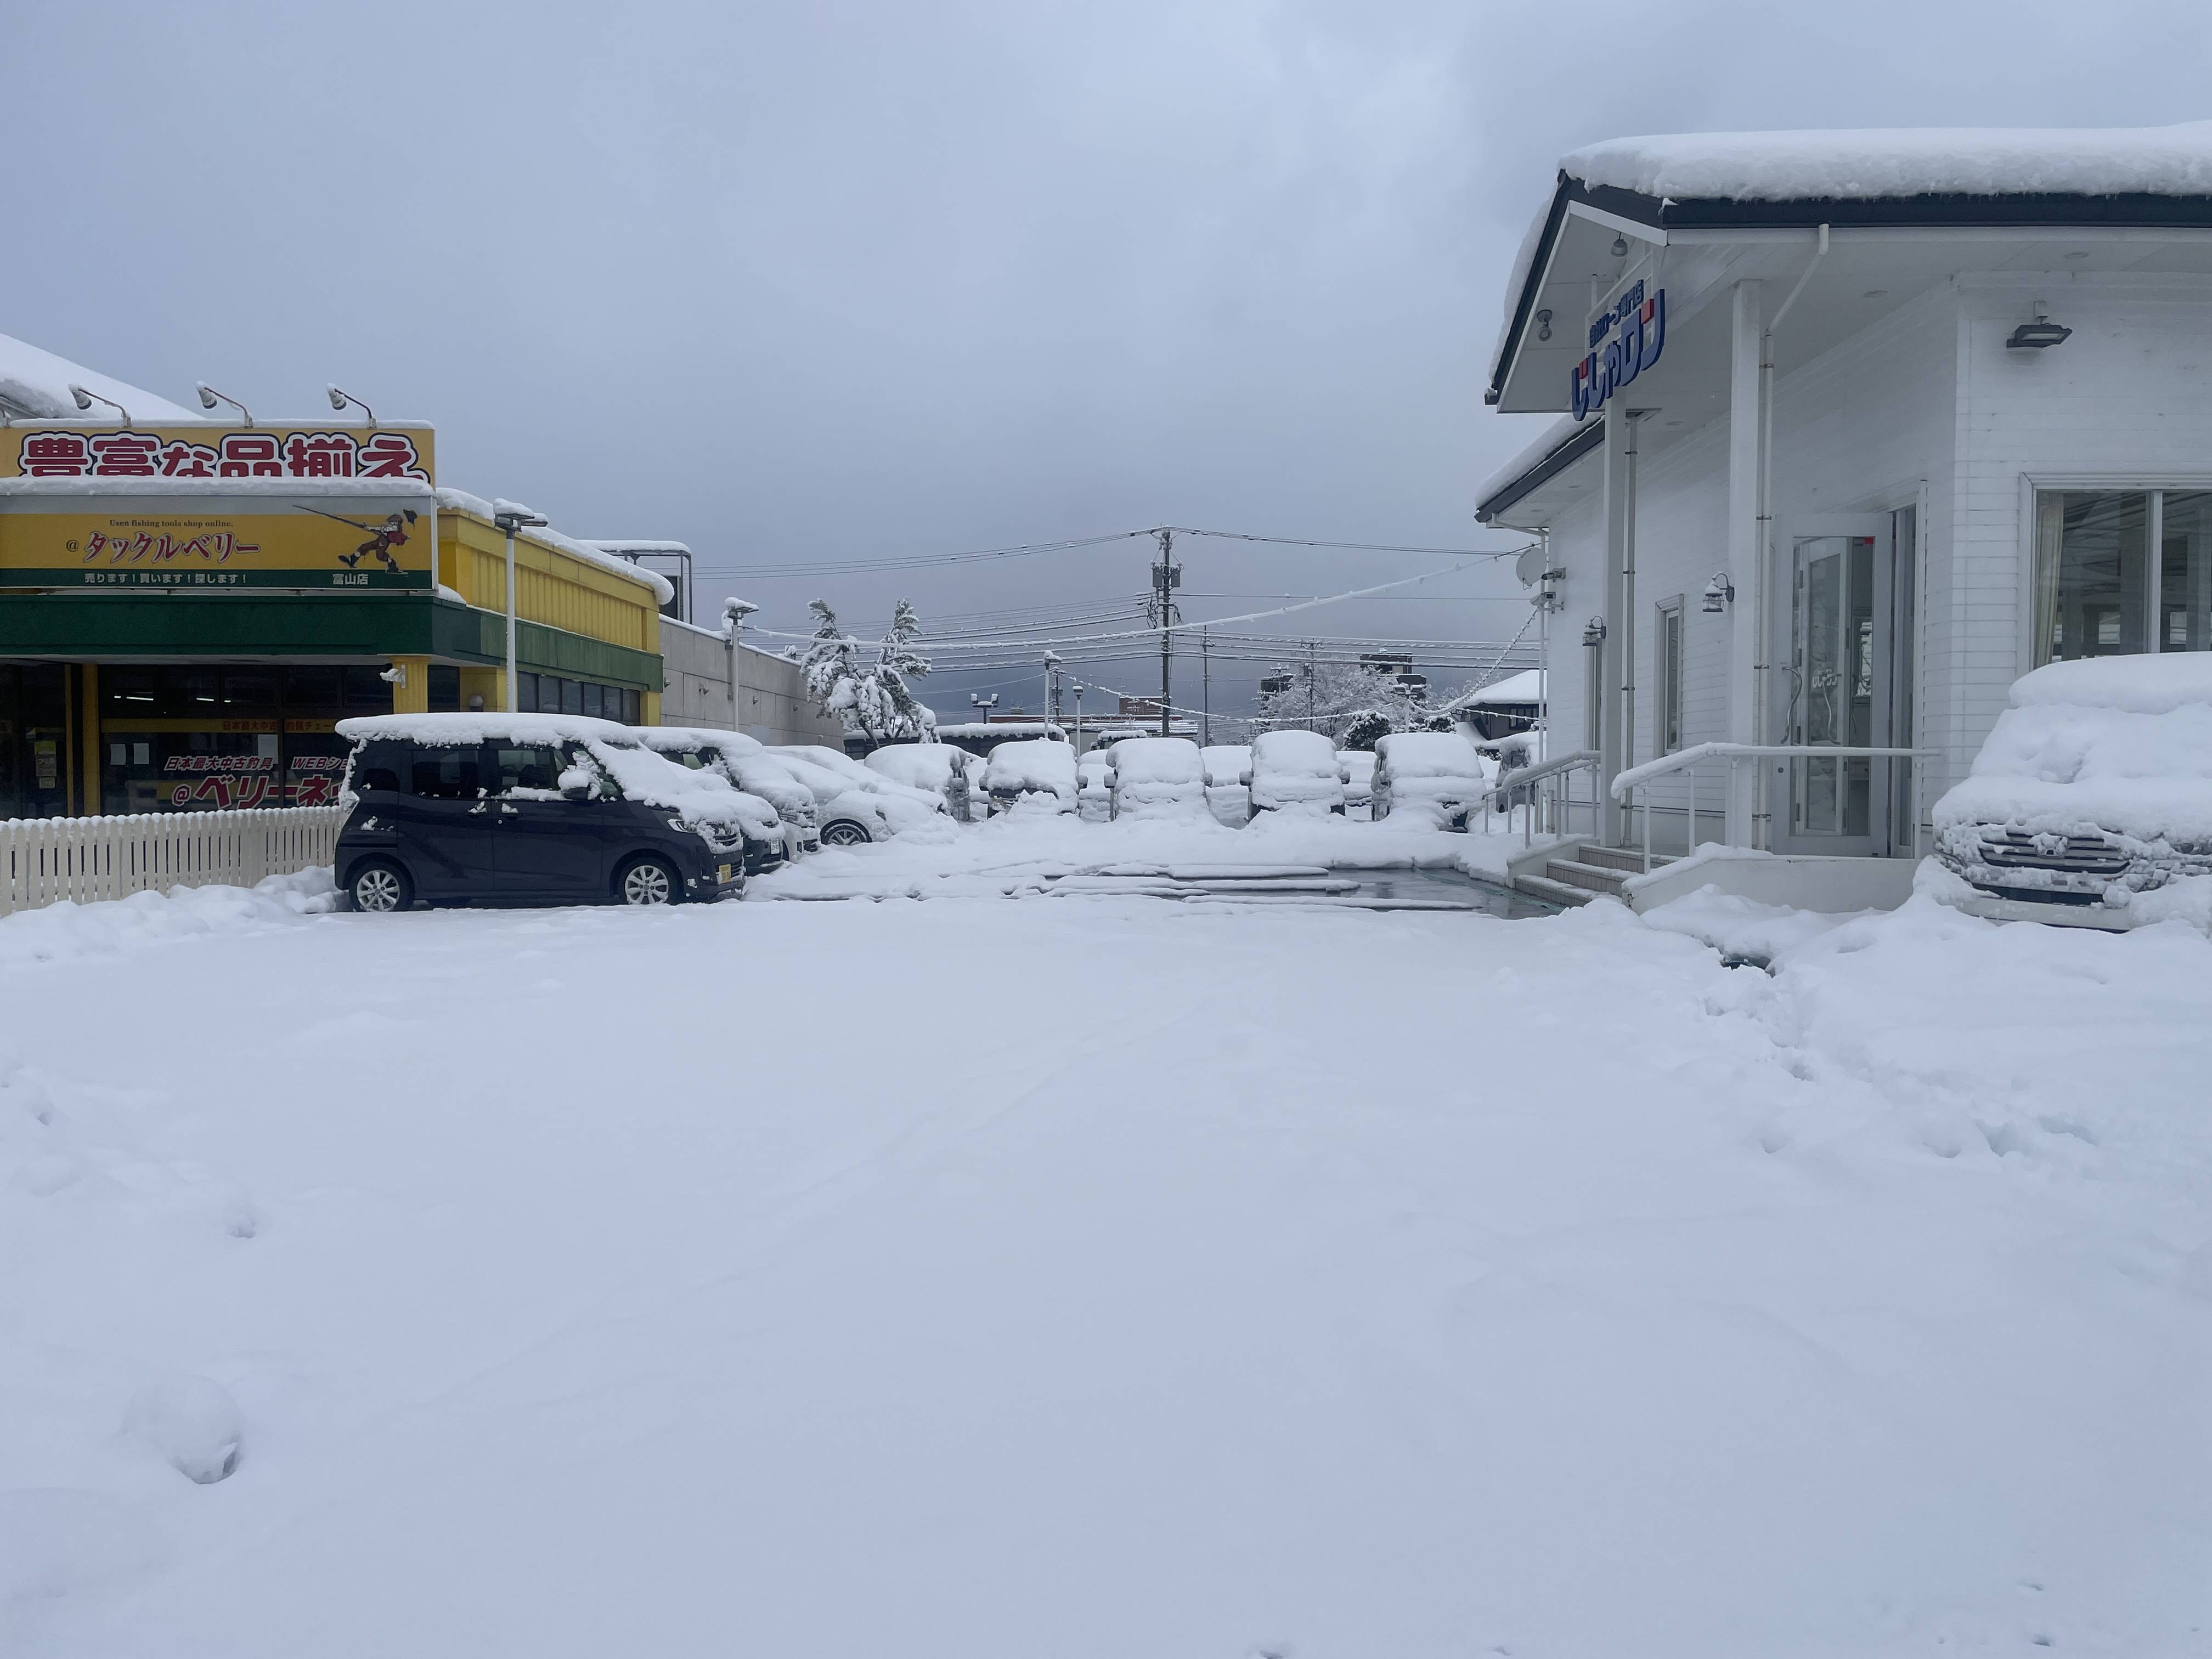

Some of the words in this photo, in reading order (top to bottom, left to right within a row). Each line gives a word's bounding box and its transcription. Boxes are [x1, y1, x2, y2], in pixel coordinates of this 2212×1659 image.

[21, 432, 428, 479] 豊富な品揃え
[132, 520, 160, 528] fishing
[184, 520, 203, 528] shop
[66, 539, 79, 552] @
[83, 531, 260, 563] タックルベリー
[332, 573, 369, 585] 富山店
[164, 755, 274, 771] 日本最大中古釣具
